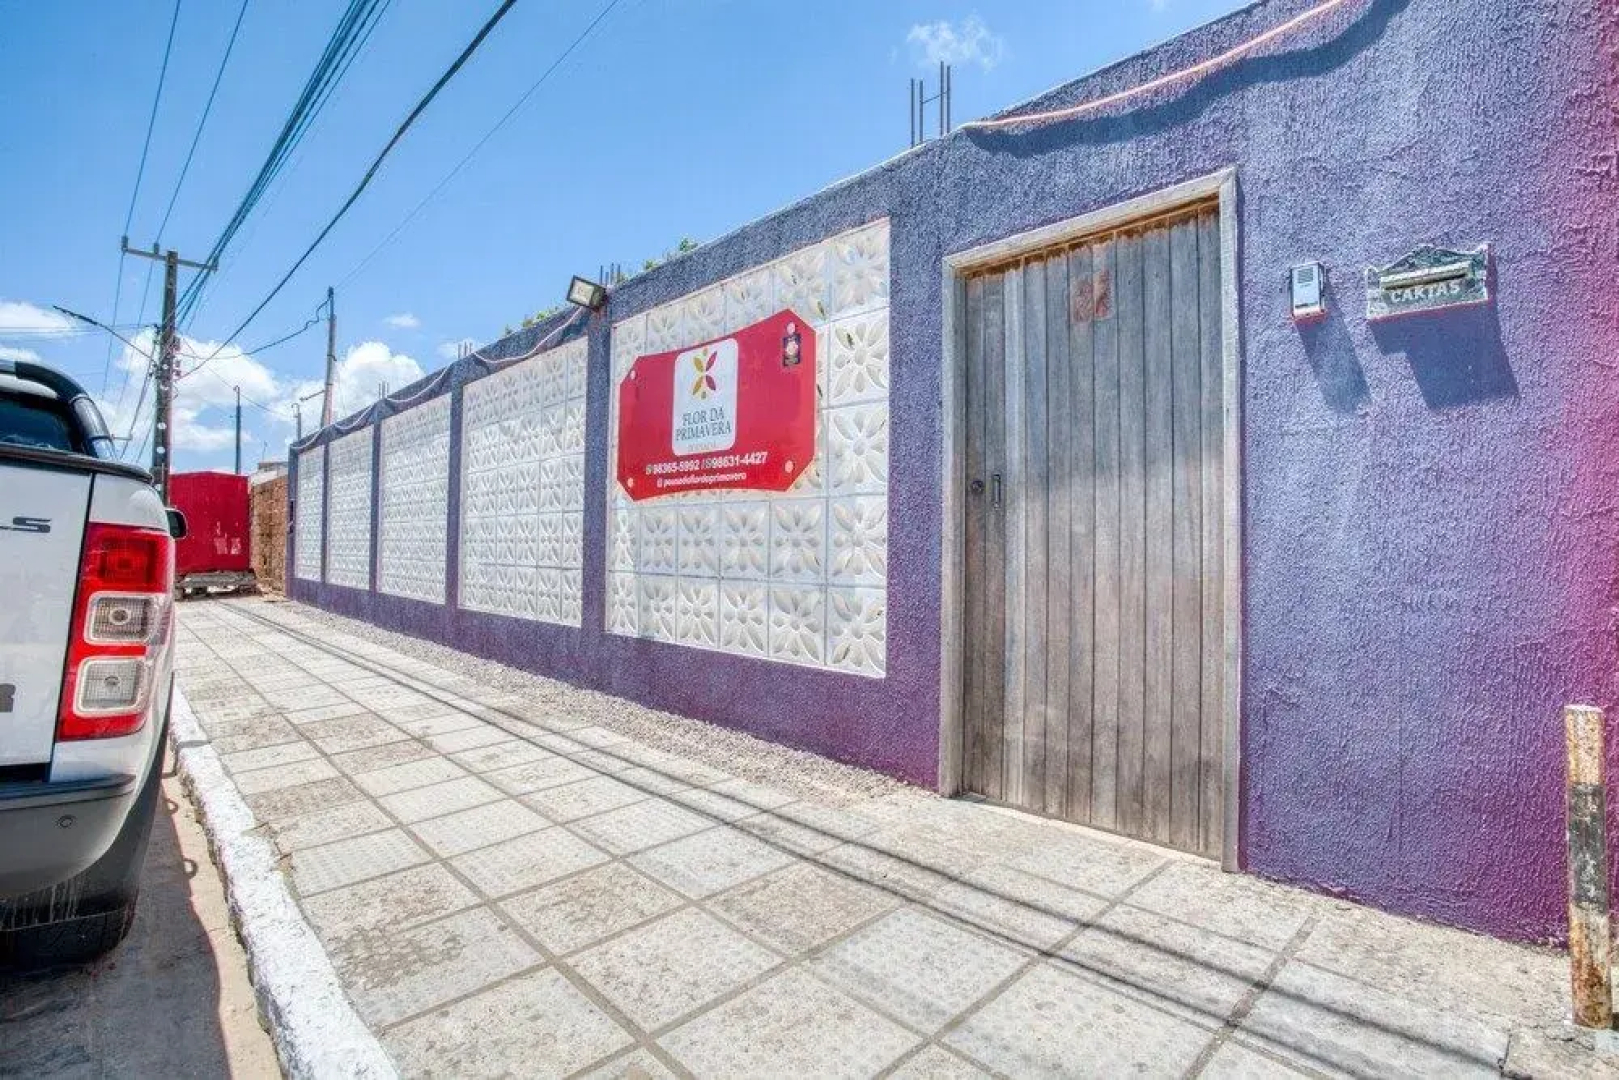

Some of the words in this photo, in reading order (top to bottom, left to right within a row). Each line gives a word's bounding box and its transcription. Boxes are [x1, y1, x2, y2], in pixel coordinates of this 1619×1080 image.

[682, 410, 708, 427] FLOR
[710, 407, 725, 422] DA
[675, 421, 732, 441] PRIMAVERA
